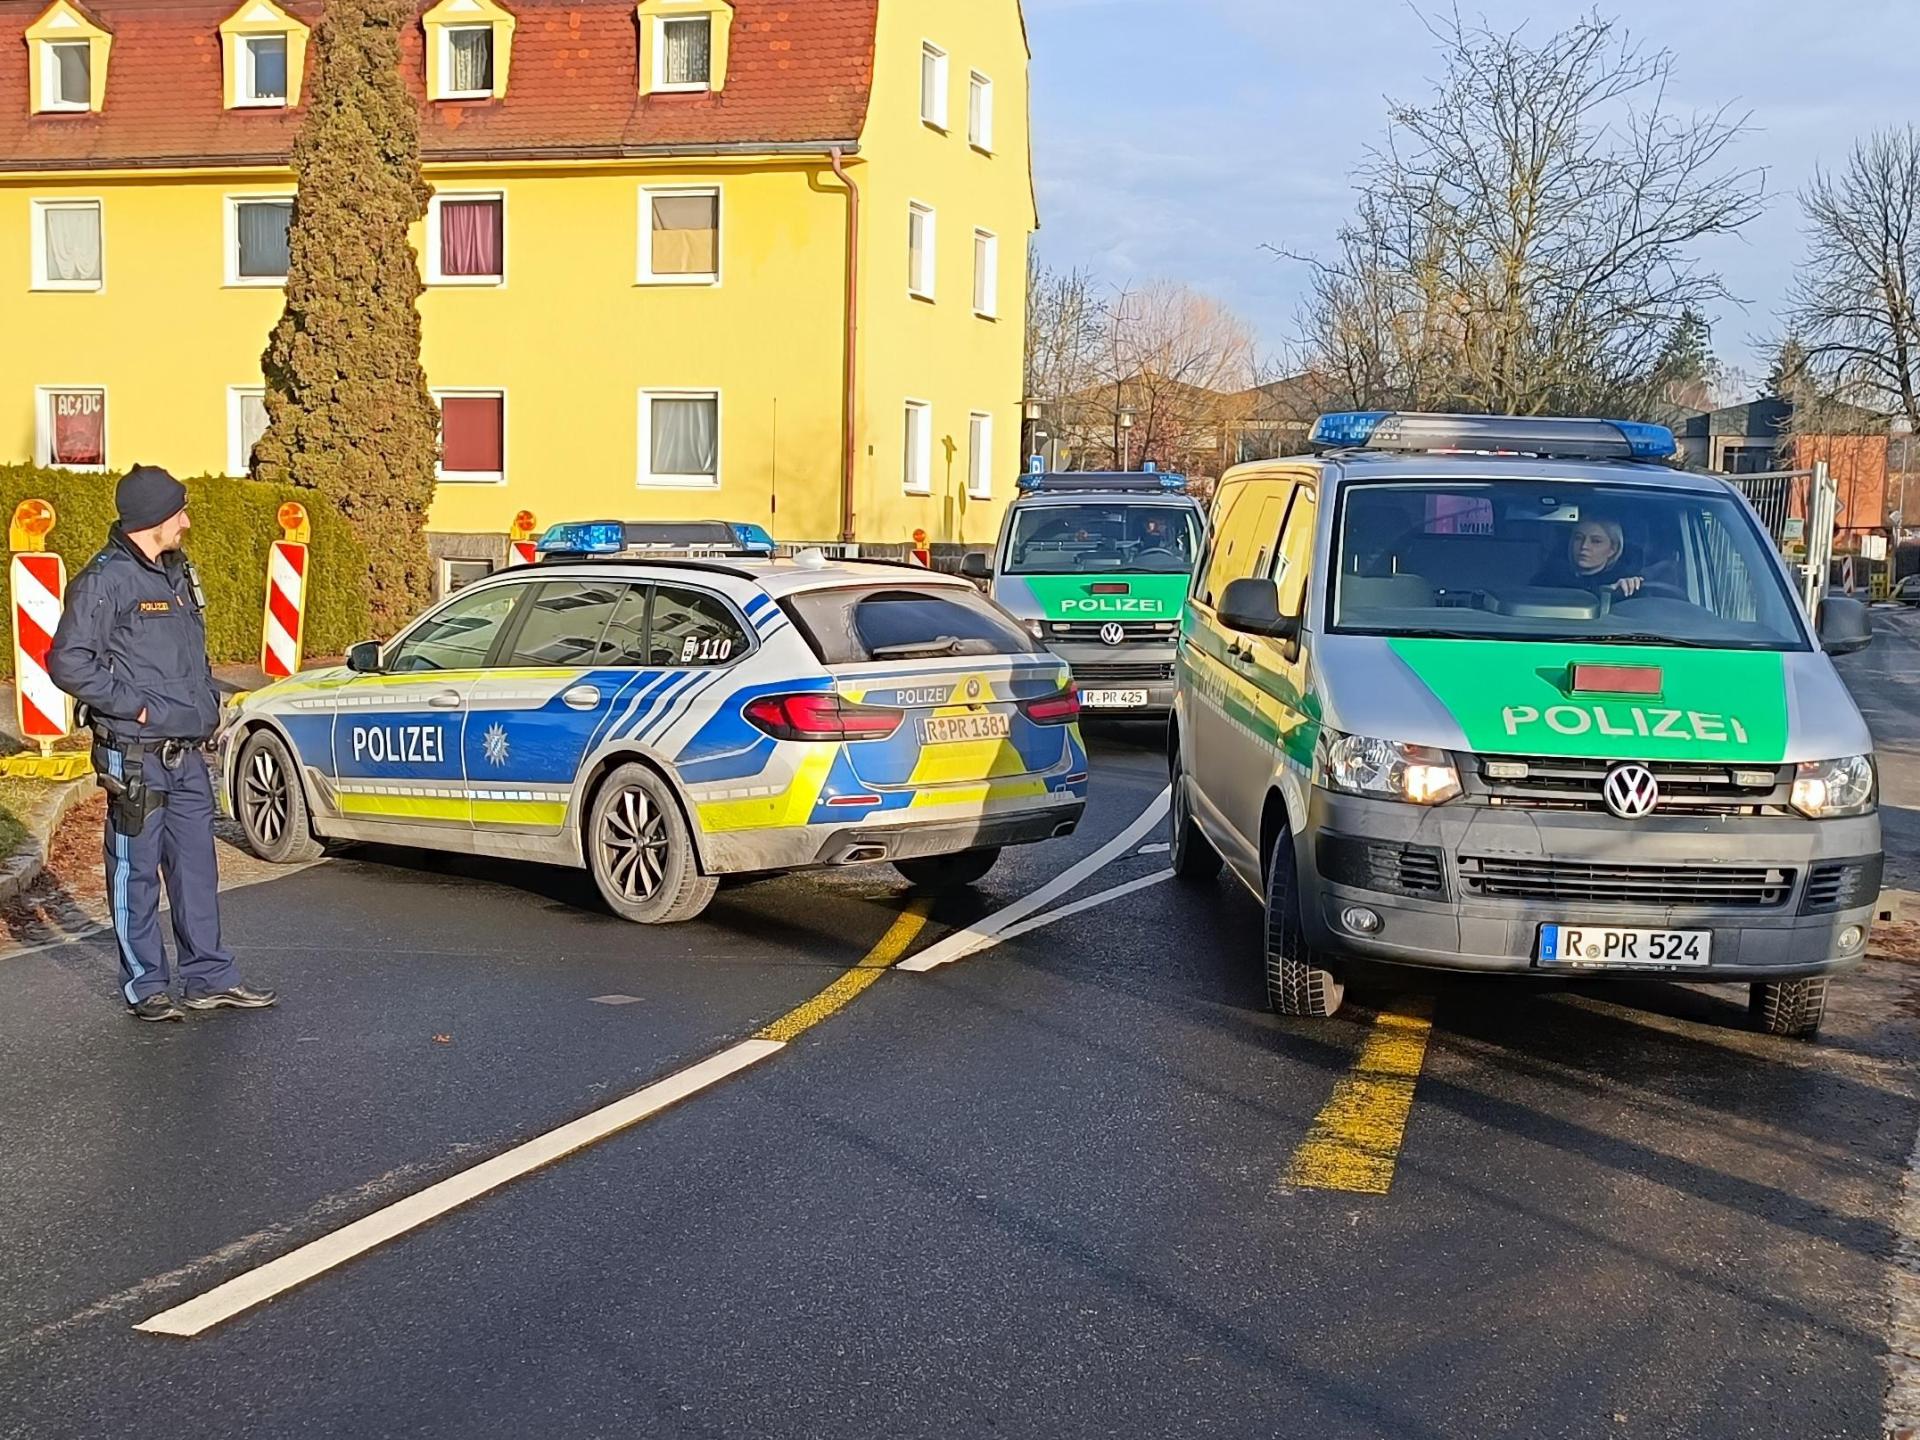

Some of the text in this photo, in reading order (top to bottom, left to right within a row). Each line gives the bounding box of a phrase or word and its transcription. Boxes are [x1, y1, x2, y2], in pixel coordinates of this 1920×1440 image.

[140, 602, 169, 611] POLIZEI
[1061, 598, 1163, 612] POLIZEI
[698, 638, 731, 660] 110
[897, 687, 947, 704] POLIZEI
[1086, 692, 1142, 703] R PR 425
[926, 715, 1009, 740] R PR 1381
[1502, 705, 1748, 744] POLIZEI
[353, 726, 444, 762] POLIZEI
[1565, 931, 1700, 960] R PR 524
